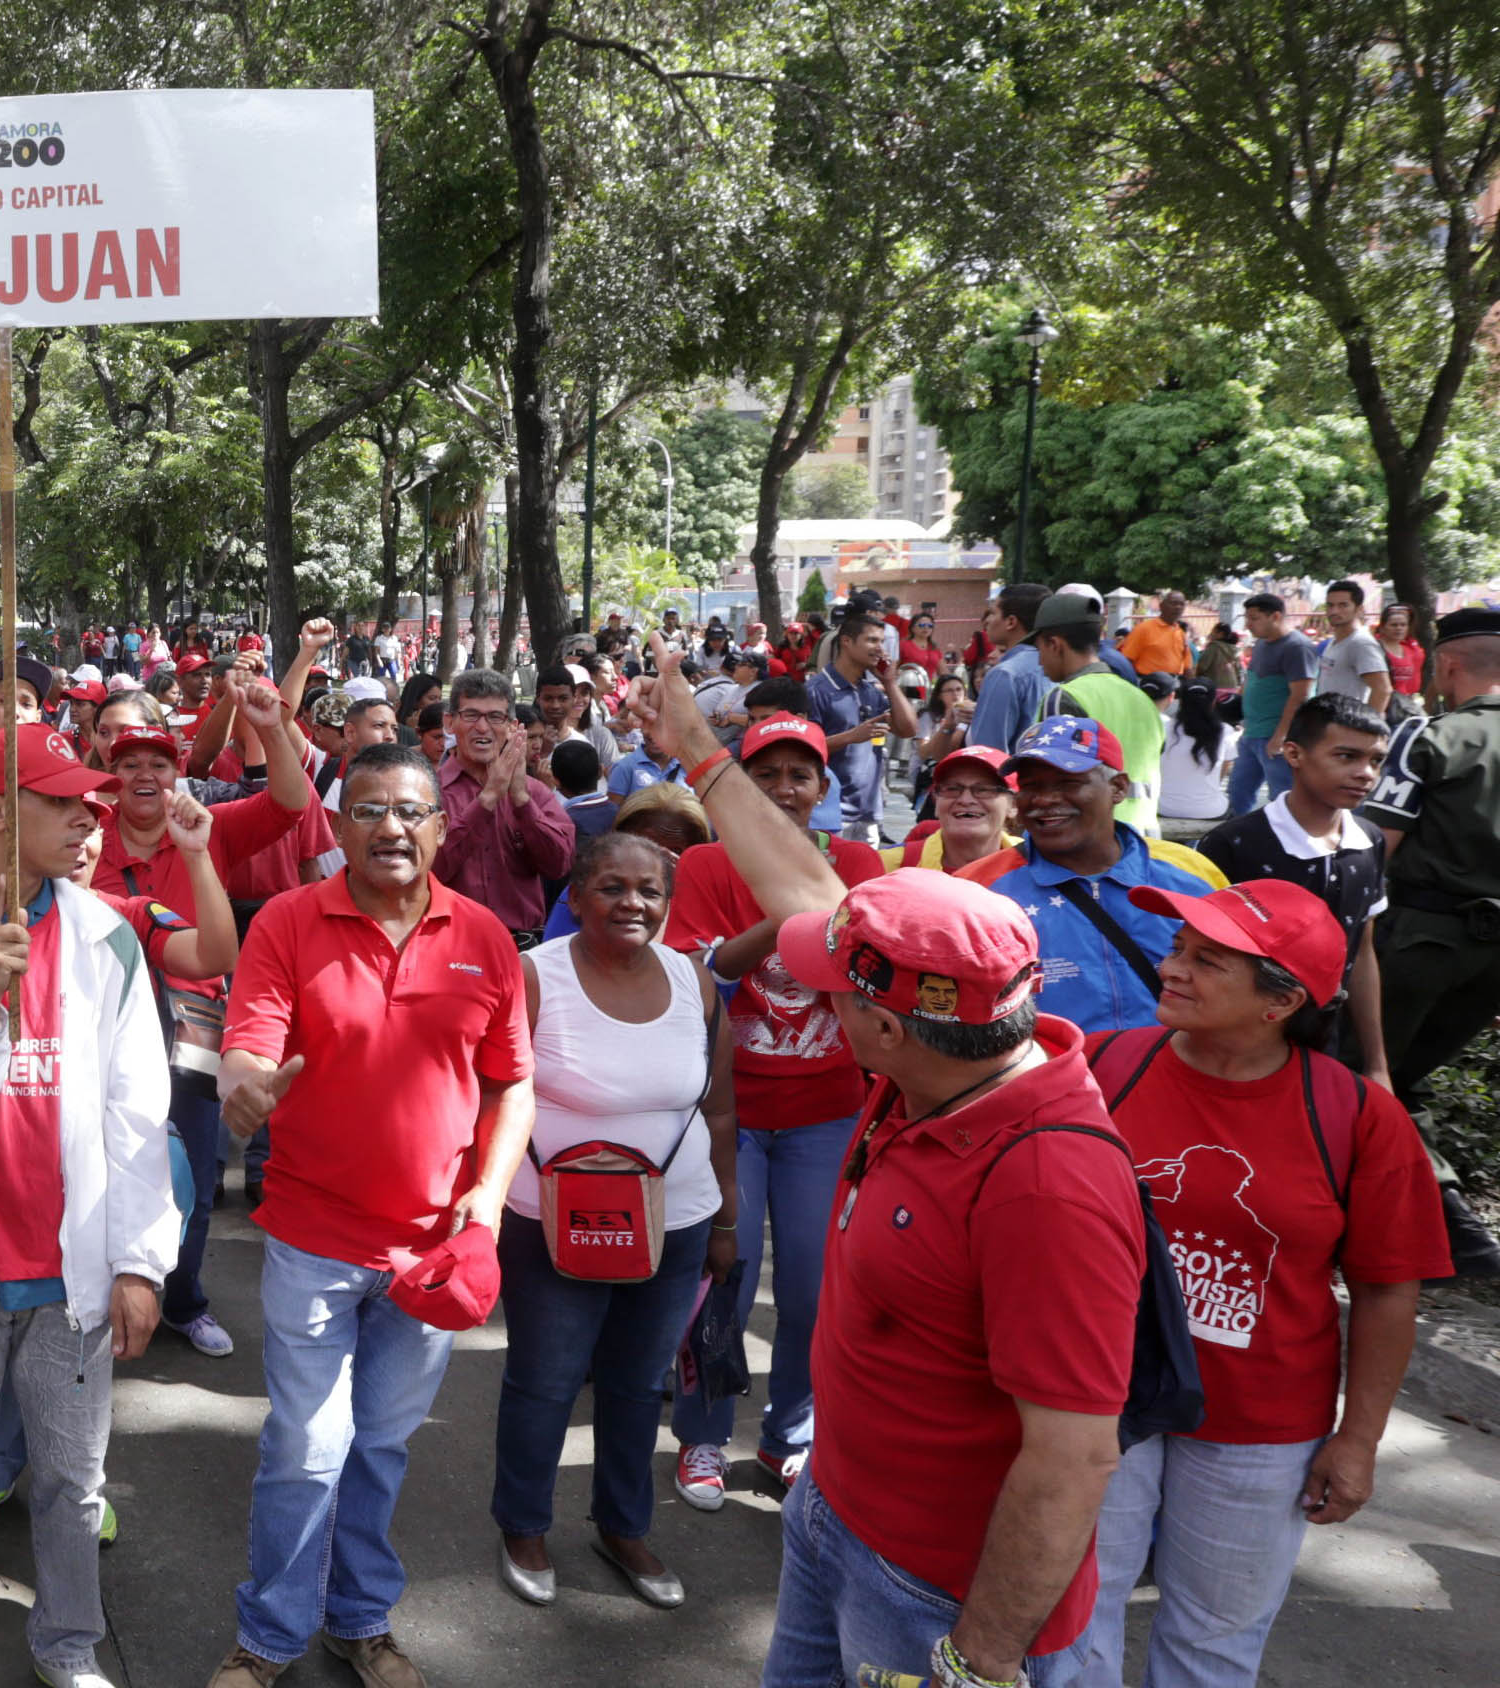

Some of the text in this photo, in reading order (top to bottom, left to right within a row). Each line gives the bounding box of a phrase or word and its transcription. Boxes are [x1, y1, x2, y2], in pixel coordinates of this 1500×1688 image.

[11, 183, 104, 210] CAPITAL
[848, 970, 877, 998] CHE
[570, 1233, 634, 1246] CHAVEZ
[1168, 1242, 1237, 1281] SOY
[1182, 1295, 1257, 1333] URO
